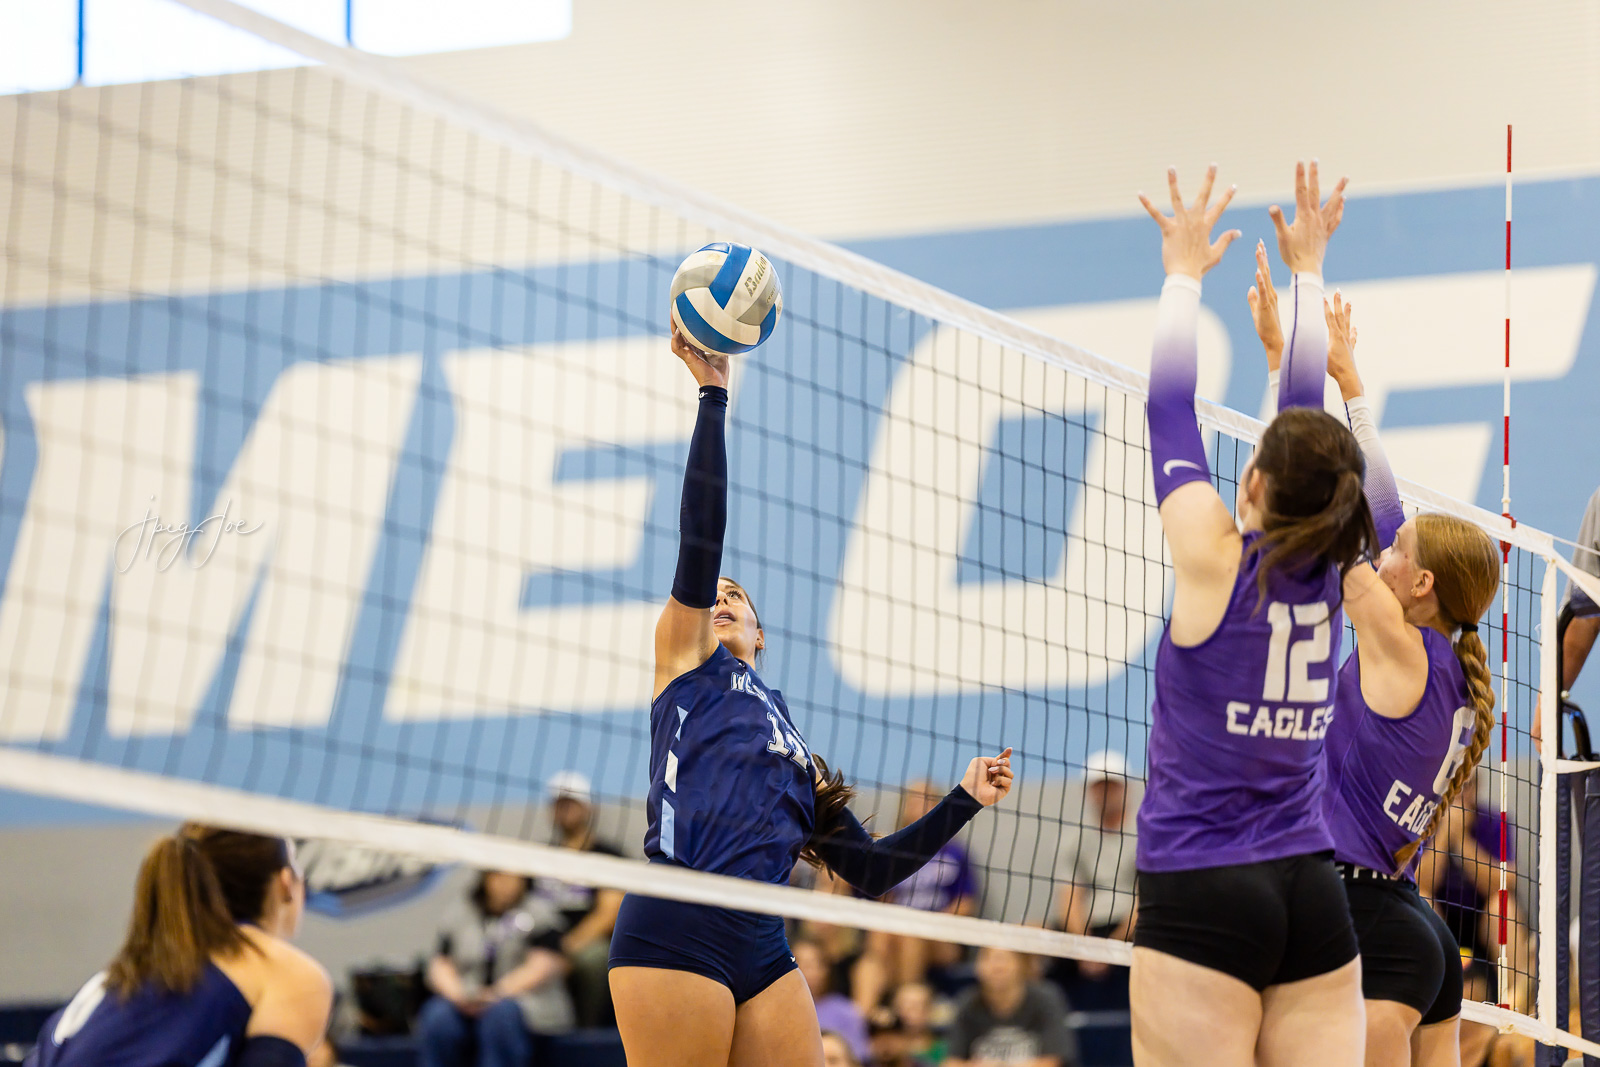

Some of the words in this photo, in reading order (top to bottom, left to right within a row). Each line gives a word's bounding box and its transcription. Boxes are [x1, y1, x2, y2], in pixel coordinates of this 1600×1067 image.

[0, 336, 746, 742] ME
[1262, 600, 1331, 703] 12
[1226, 700, 1335, 741] EAGLES
